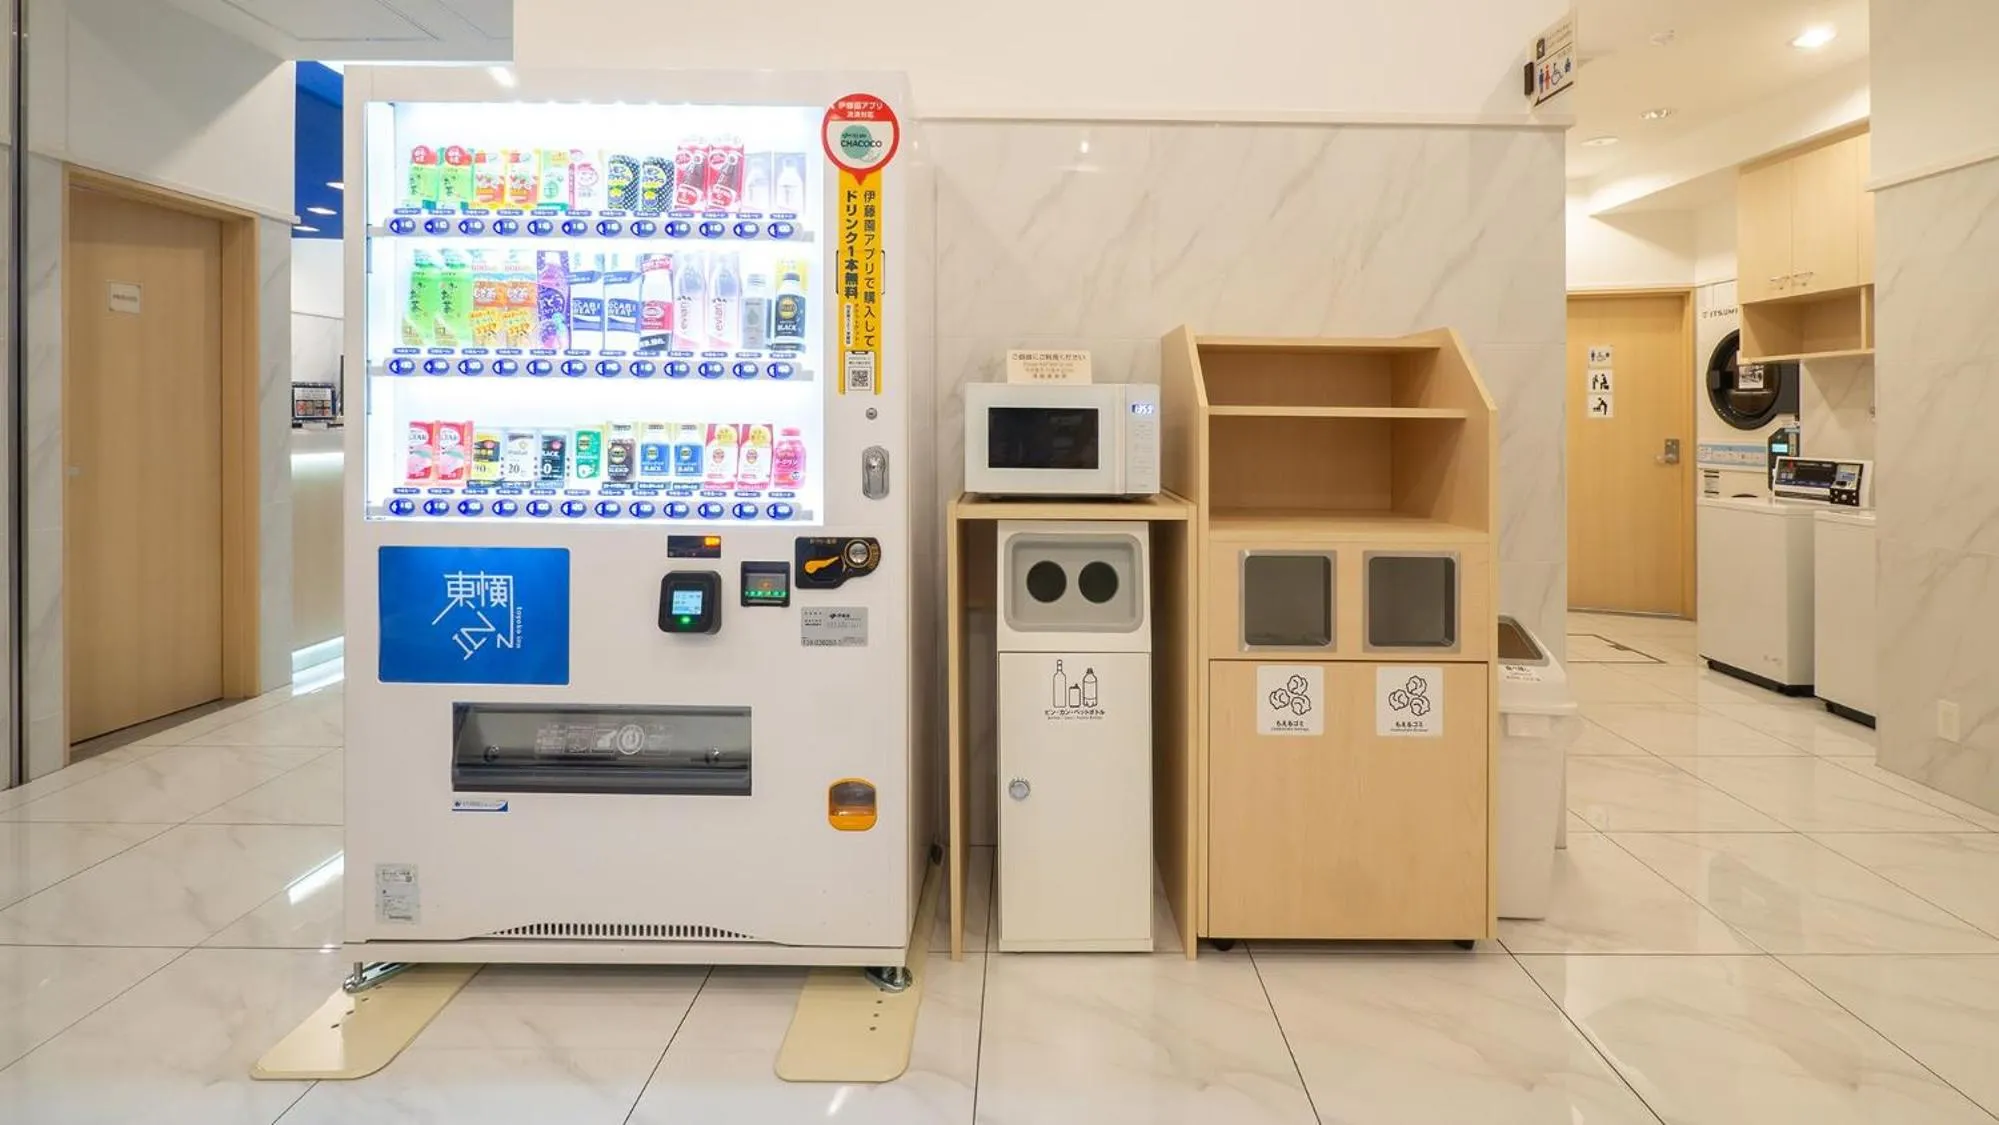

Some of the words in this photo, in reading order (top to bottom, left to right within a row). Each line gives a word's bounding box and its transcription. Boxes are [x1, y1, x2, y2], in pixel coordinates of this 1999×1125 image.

[841, 140, 882, 148] CHACOCO
[844, 190, 859, 299] ドリンク1本無料
[864, 190, 876, 347] 伊藤園アプリで購入して
